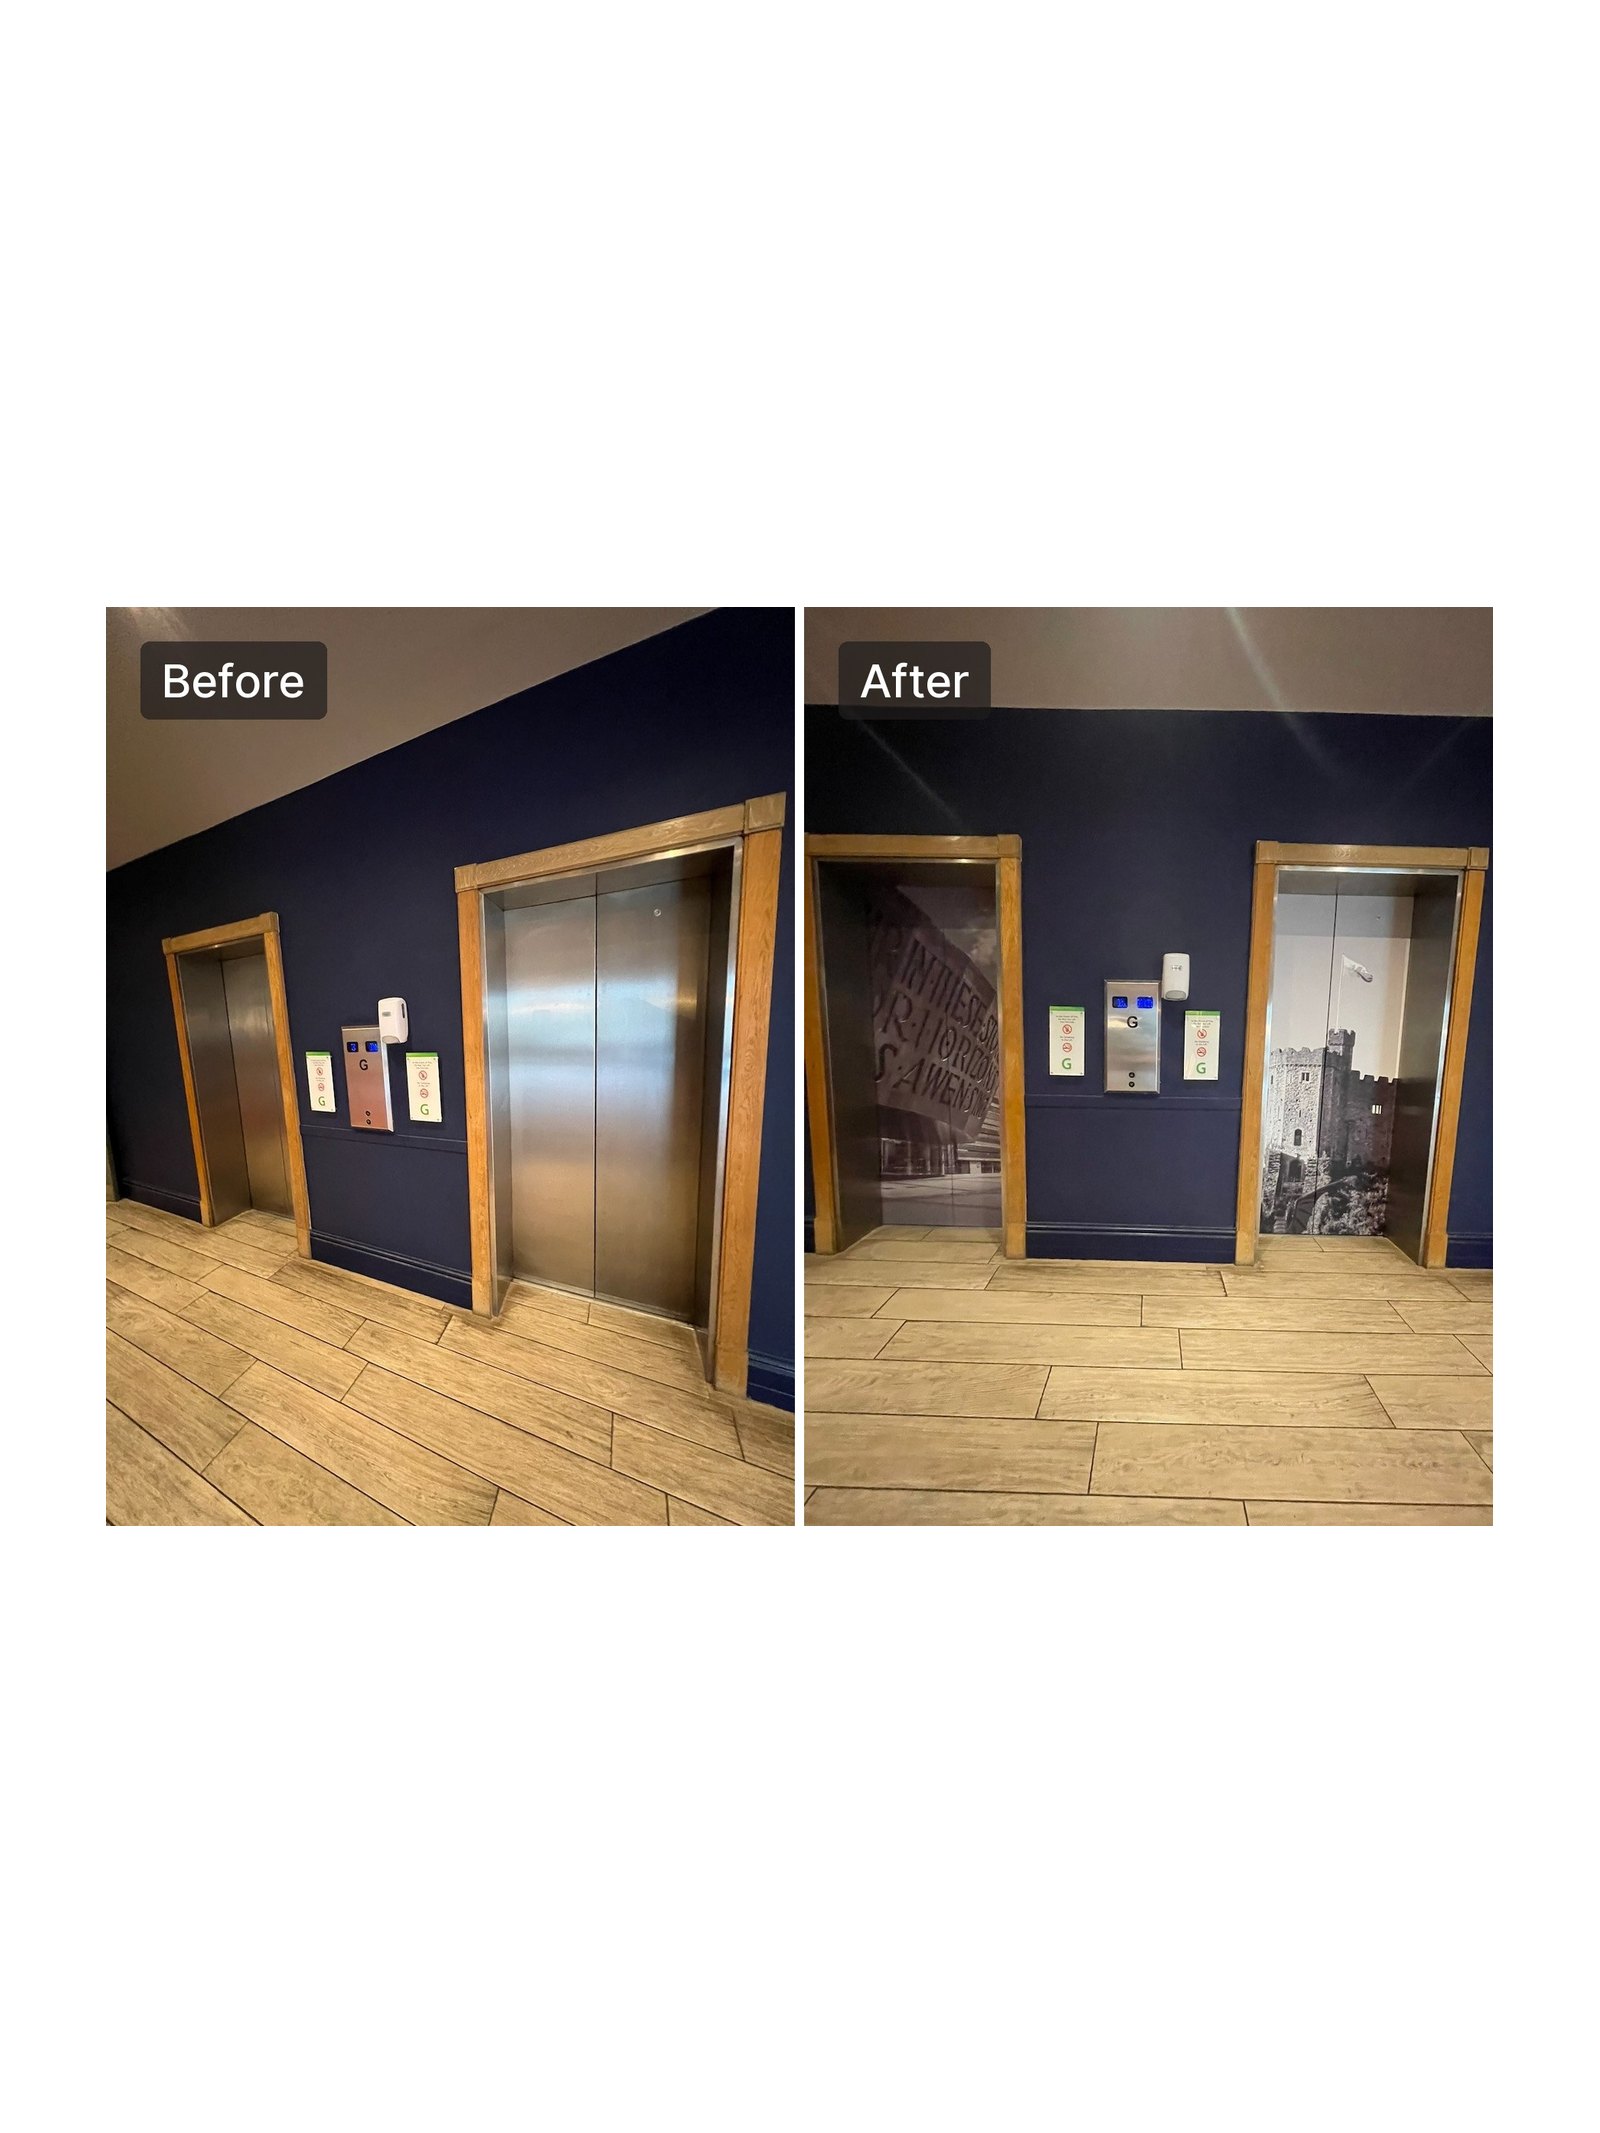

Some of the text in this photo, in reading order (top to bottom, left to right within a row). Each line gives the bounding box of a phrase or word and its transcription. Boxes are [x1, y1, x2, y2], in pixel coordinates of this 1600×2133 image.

[1127, 1015, 1139, 1029] G
[359, 1059, 369, 1071] G
[1061, 1057, 1072, 1070] G
[1196, 1062, 1207, 1075] G
[318, 1095, 326, 1106] G
[420, 1103, 430, 1116] G
